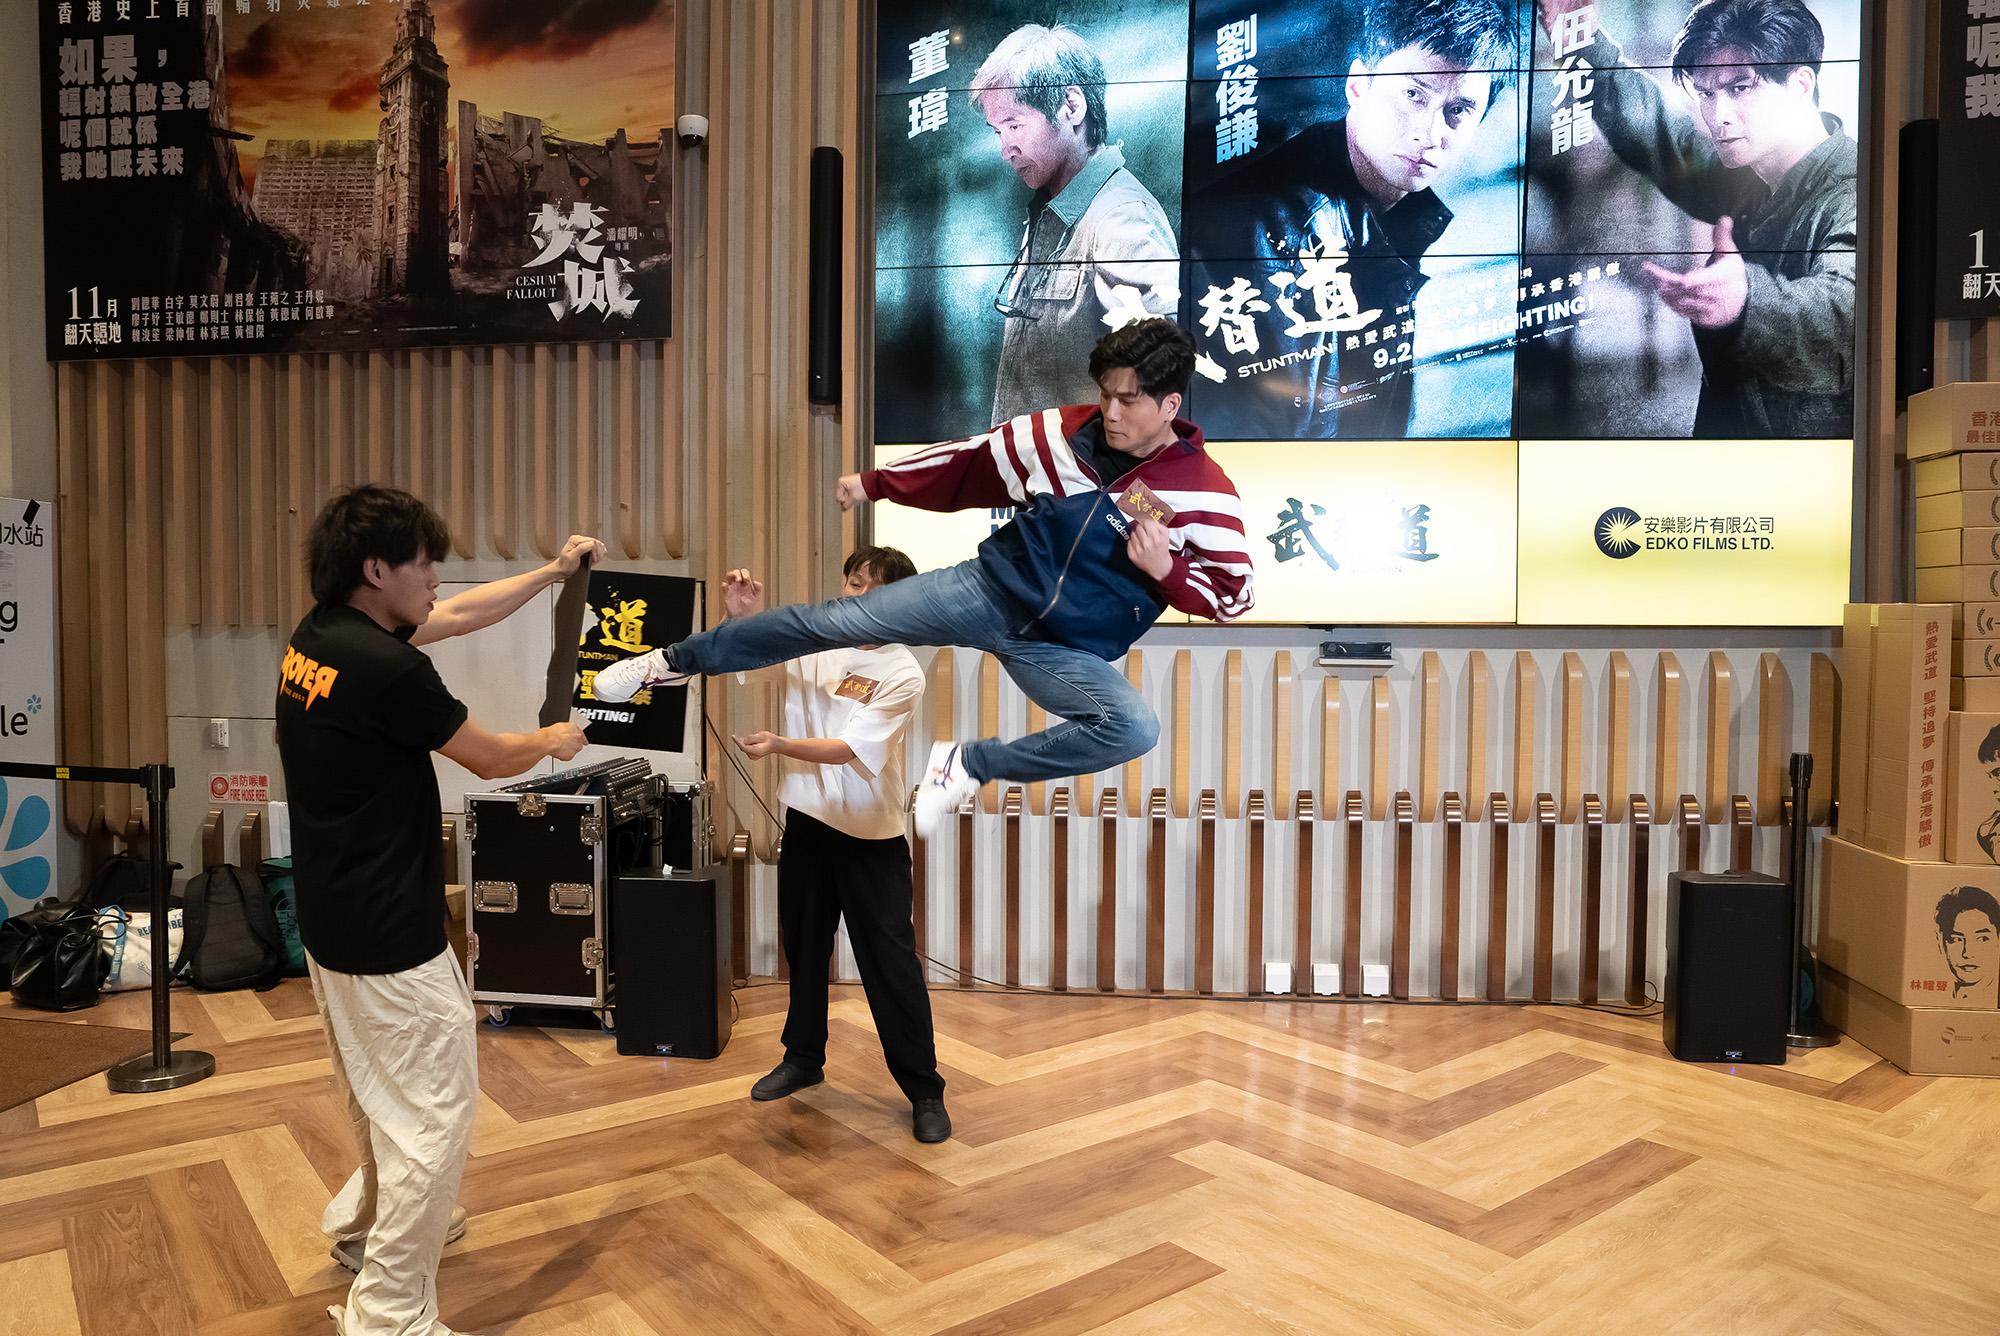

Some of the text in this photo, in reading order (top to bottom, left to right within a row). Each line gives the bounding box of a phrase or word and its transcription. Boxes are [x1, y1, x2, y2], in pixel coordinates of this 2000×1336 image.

[59, 80, 210, 117] 輻射擴散全港
[908, 28, 951, 140] 董瑋
[1216, 13, 1259, 164] 劉俊謙
[1550, 7, 1595, 156] 伍允龍
[59, 115, 158, 149] 呢個就係
[60, 146, 184, 181] 我哋嘅未來
[506, 286, 557, 300] FALLOUT
[515, 273, 557, 287] CESIUM
[67, 285, 118, 320] 11月
[1237, 344, 1335, 378] STUNTMAN
[0, 522, 44, 547] 水站
[1105, 513, 1130, 541] adidas
[1266, 497, 1440, 571] 武道
[1643, 516, 1775, 535] 安樂影片有限公司
[1645, 537, 1775, 550] EDKO FILMS LTD.
[577, 650, 620, 662] TUNTMAN
[1924, 620, 1939, 681] 熱愛武道
[573, 706, 637, 724] GHTING!
[1921, 689, 1938, 750] 堅持追夢
